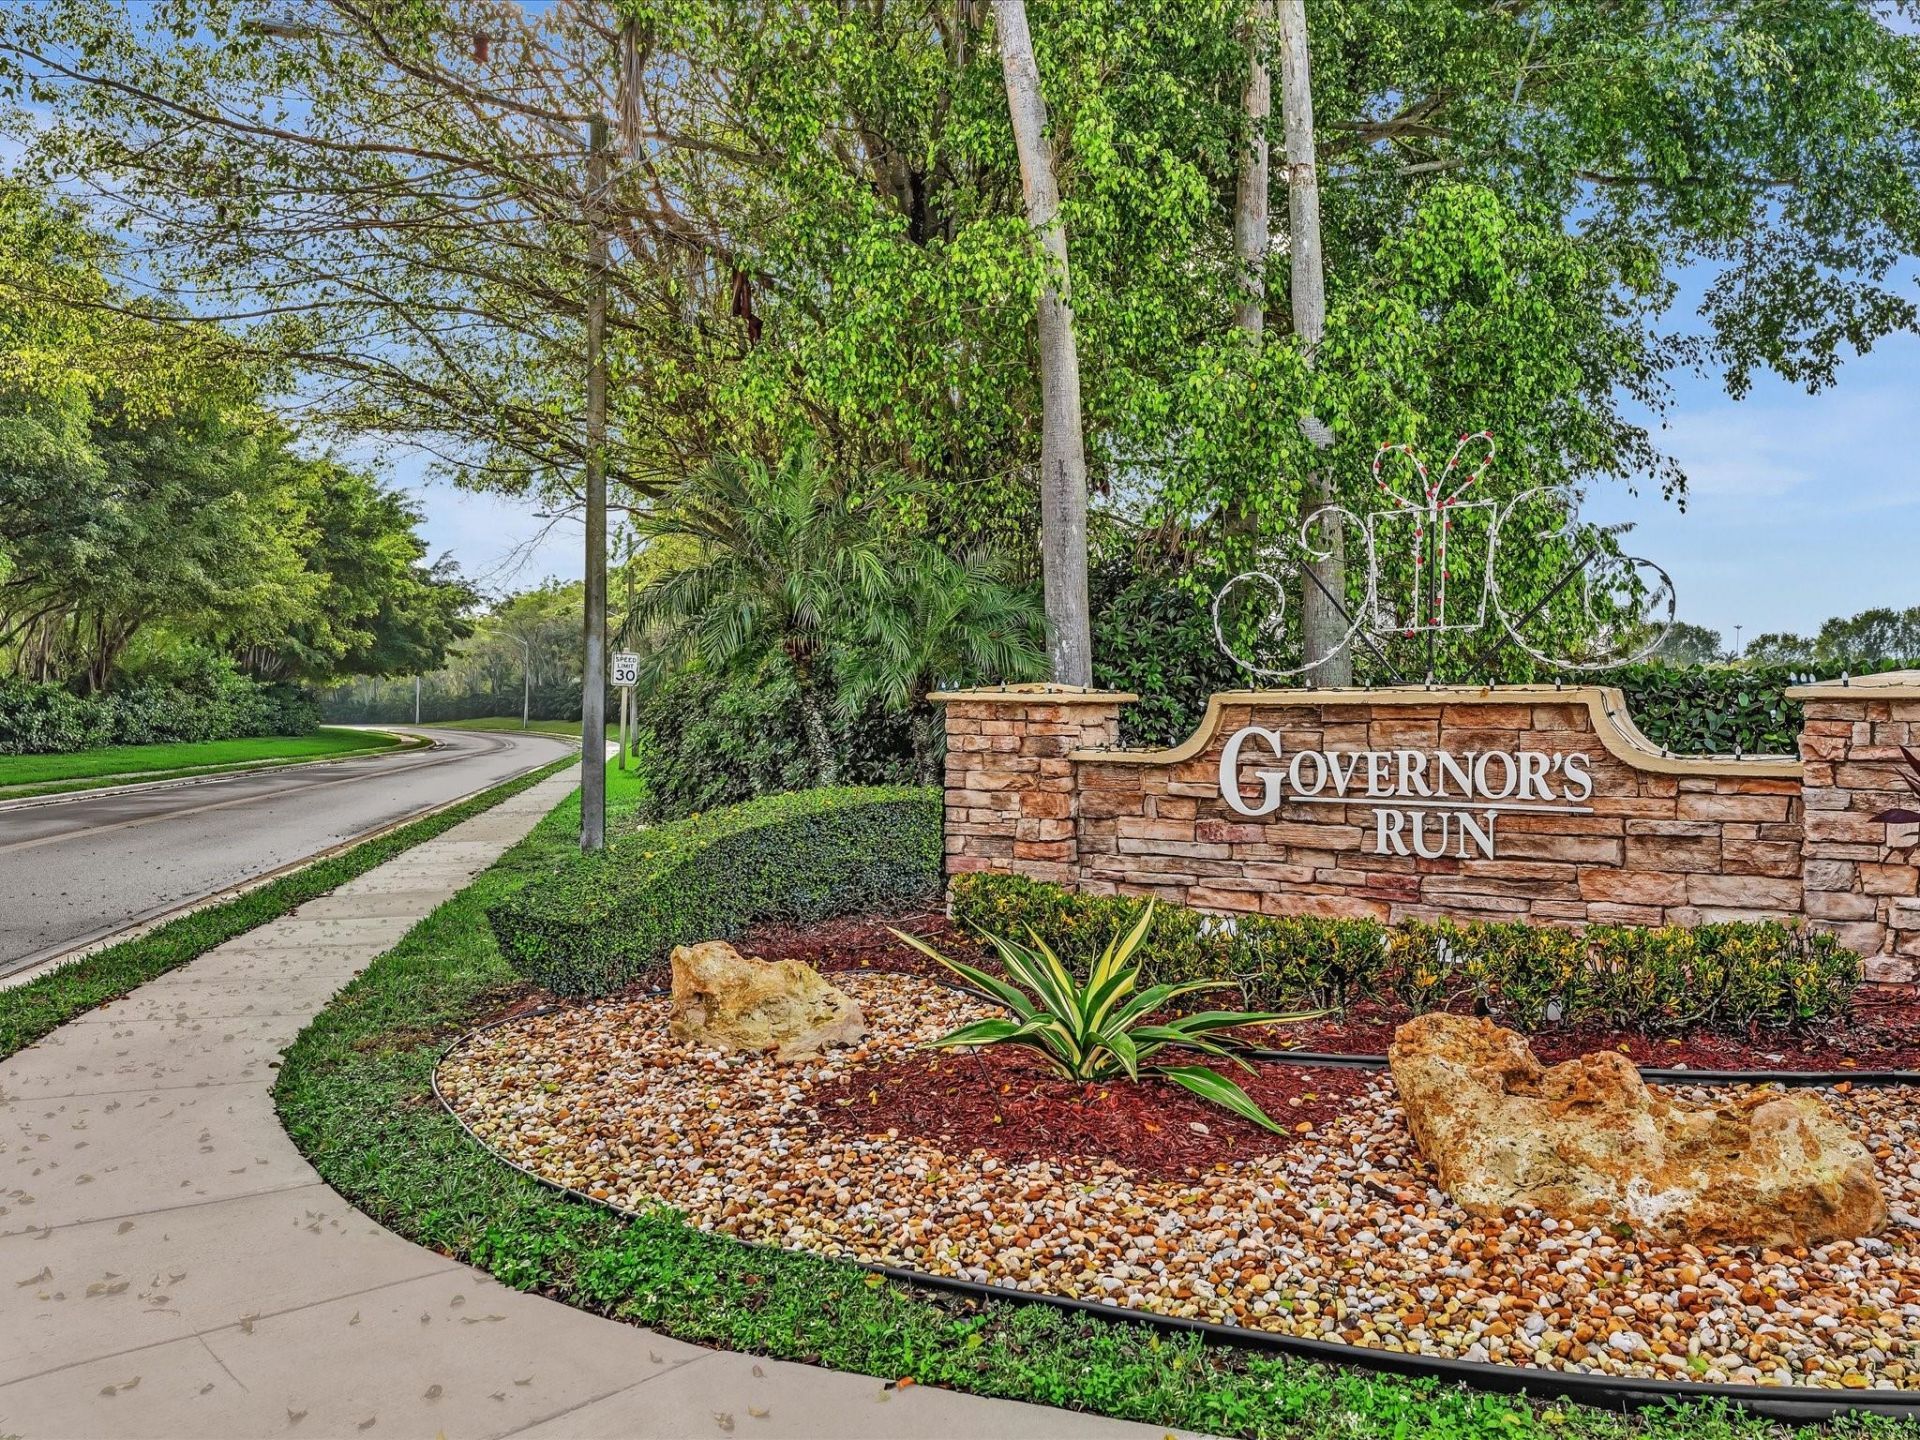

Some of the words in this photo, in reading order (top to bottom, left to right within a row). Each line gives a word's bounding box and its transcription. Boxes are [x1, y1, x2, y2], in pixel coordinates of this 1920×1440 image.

[615, 669, 636, 681] 30
[1219, 726, 1594, 817] GOVERNOR'S
[1372, 808, 1498, 861] RUN
